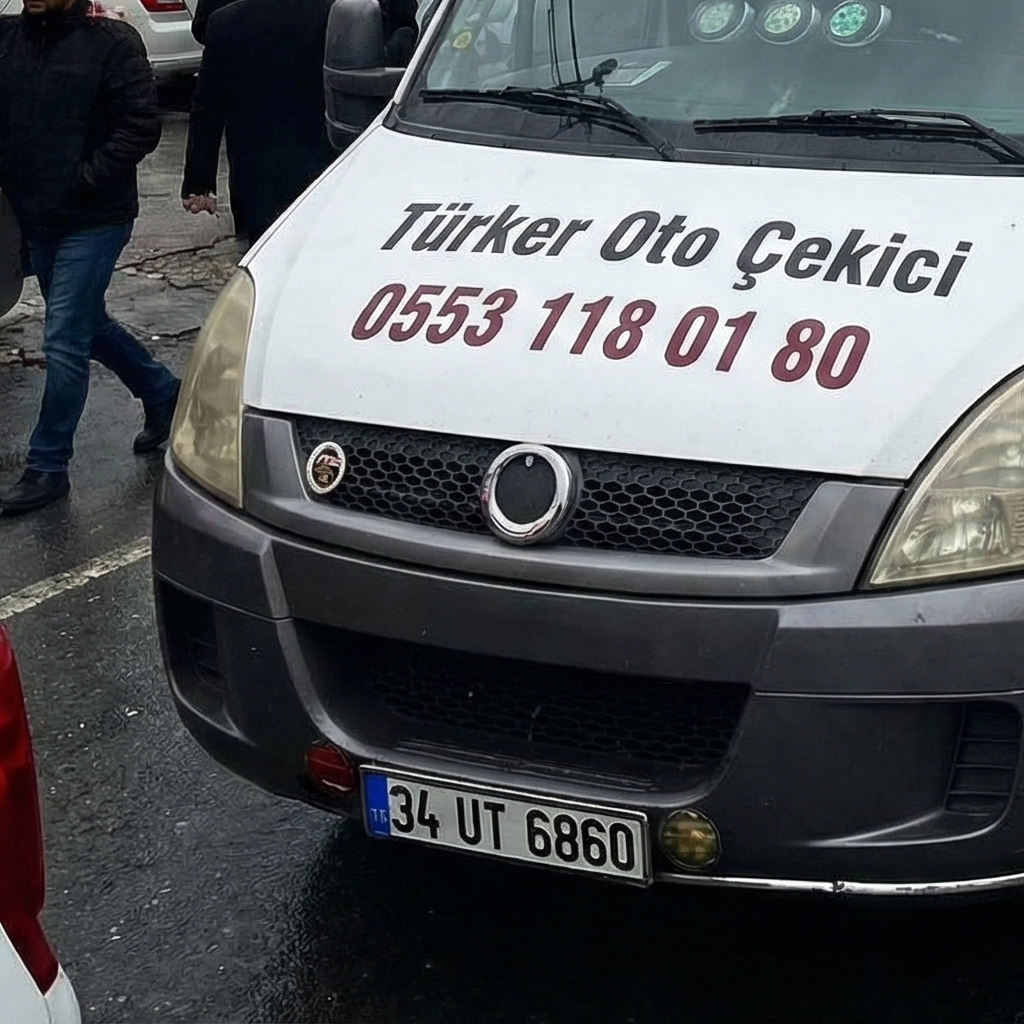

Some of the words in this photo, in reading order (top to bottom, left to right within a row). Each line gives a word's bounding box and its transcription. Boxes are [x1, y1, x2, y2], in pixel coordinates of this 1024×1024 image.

[381, 203, 593, 256] Türker
[600, 211, 719, 267] Oto
[732, 221, 973, 297] Çekici
[351, 284, 517, 346] 0553
[530, 293, 656, 360] 118
[665, 306, 757, 372] 01
[771, 319, 870, 389] 80
[389, 784, 440, 840] 34
[456, 796, 506, 851] UT
[525, 809, 636, 872] 6860
